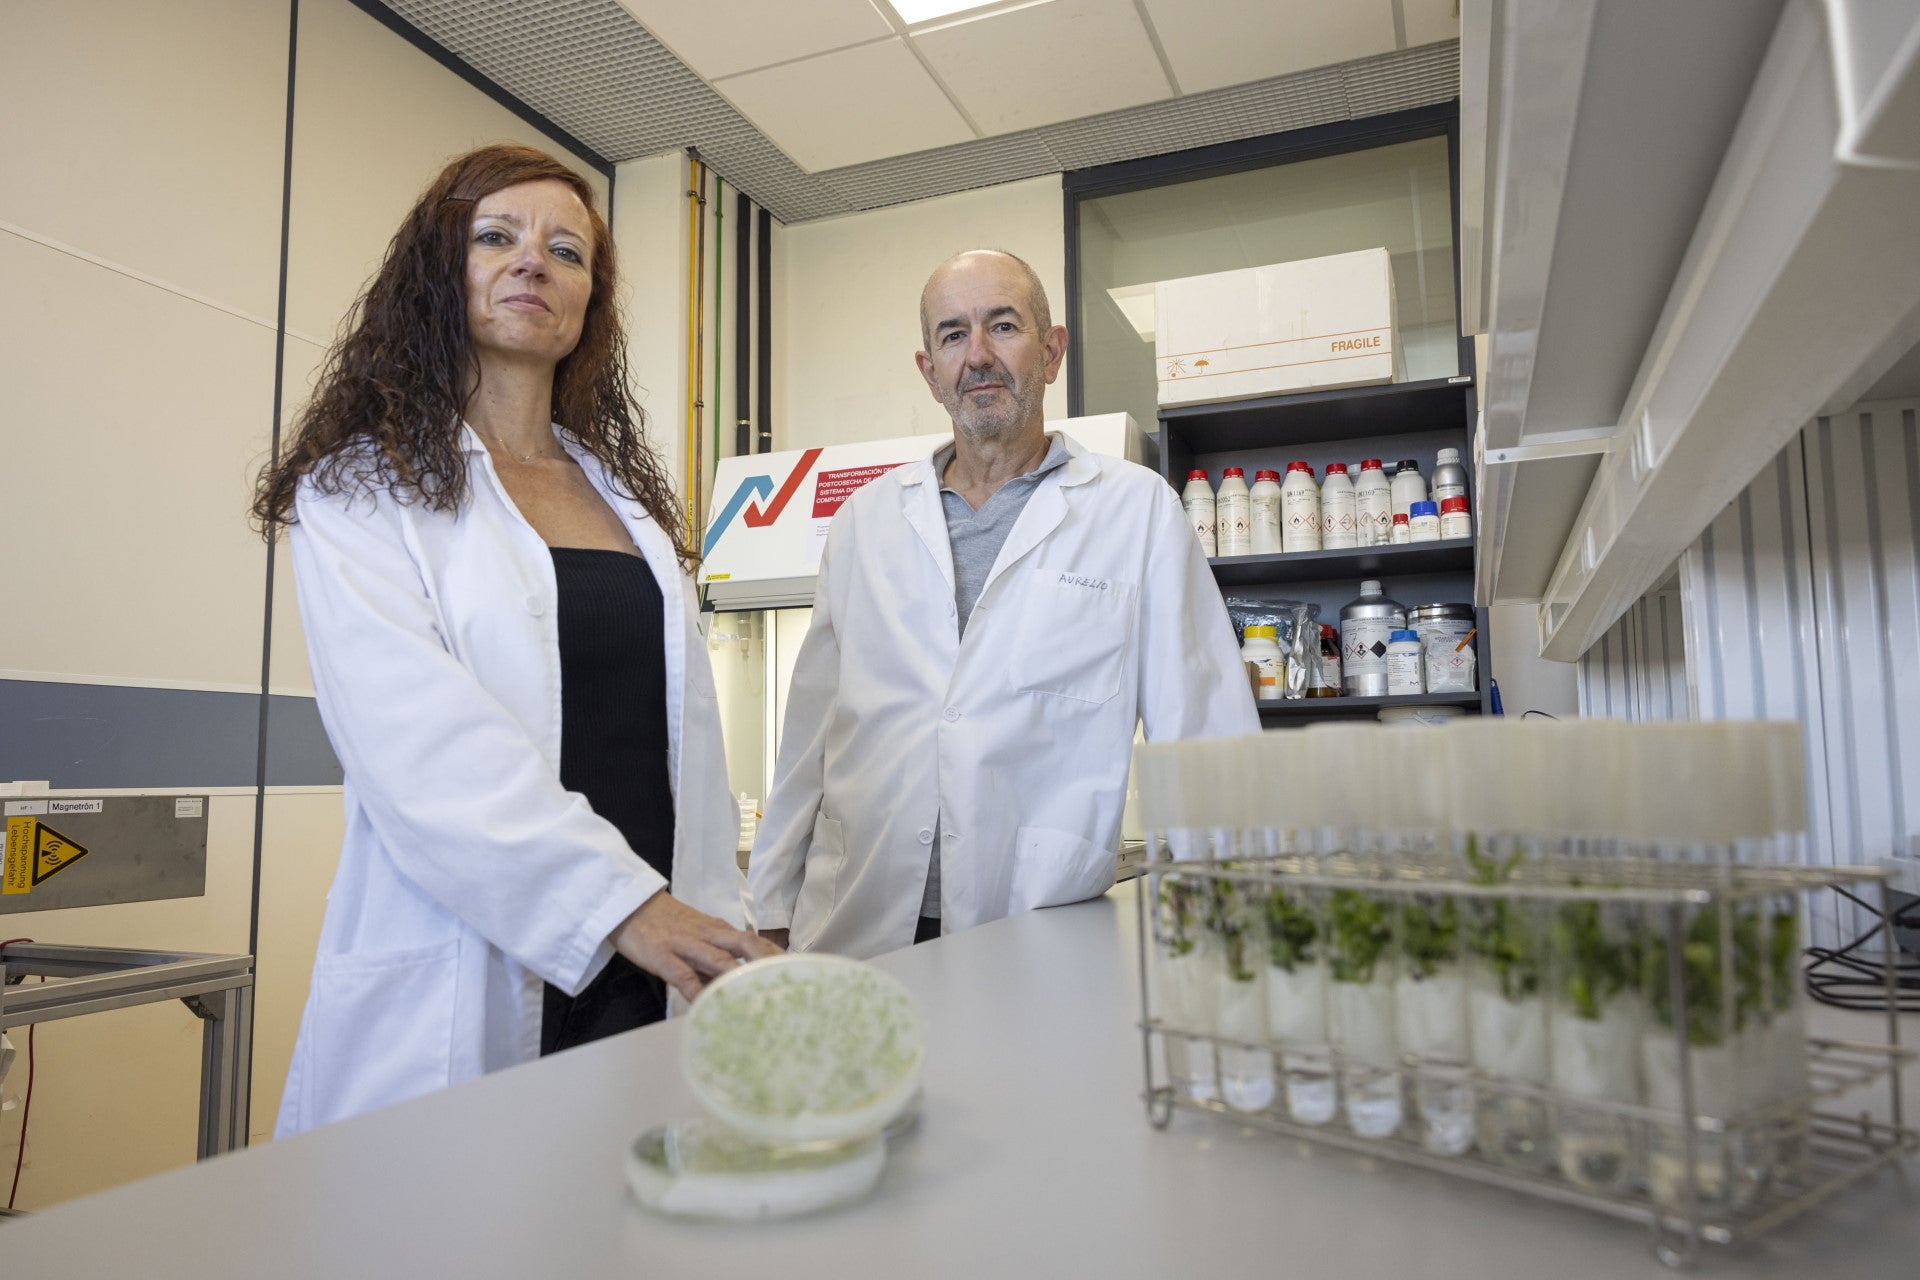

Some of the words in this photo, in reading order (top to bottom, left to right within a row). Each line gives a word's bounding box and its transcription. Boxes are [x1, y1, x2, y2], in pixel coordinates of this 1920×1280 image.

[1331, 336, 1381, 352] FRAGILE
[828, 468, 882, 479] TRANSFORMACIÓN
[818, 480, 862, 488] POSTCOSECHA
[820, 488, 845, 496] SISTEMA
[1059, 574, 1108, 590] AURELIO
[52, 802, 94, 812] Magnetrón
[96, 802, 100, 810] 1
[8, 824, 20, 886] Lebensgefahr
[17, 821, 32, 889] Hochspannung
